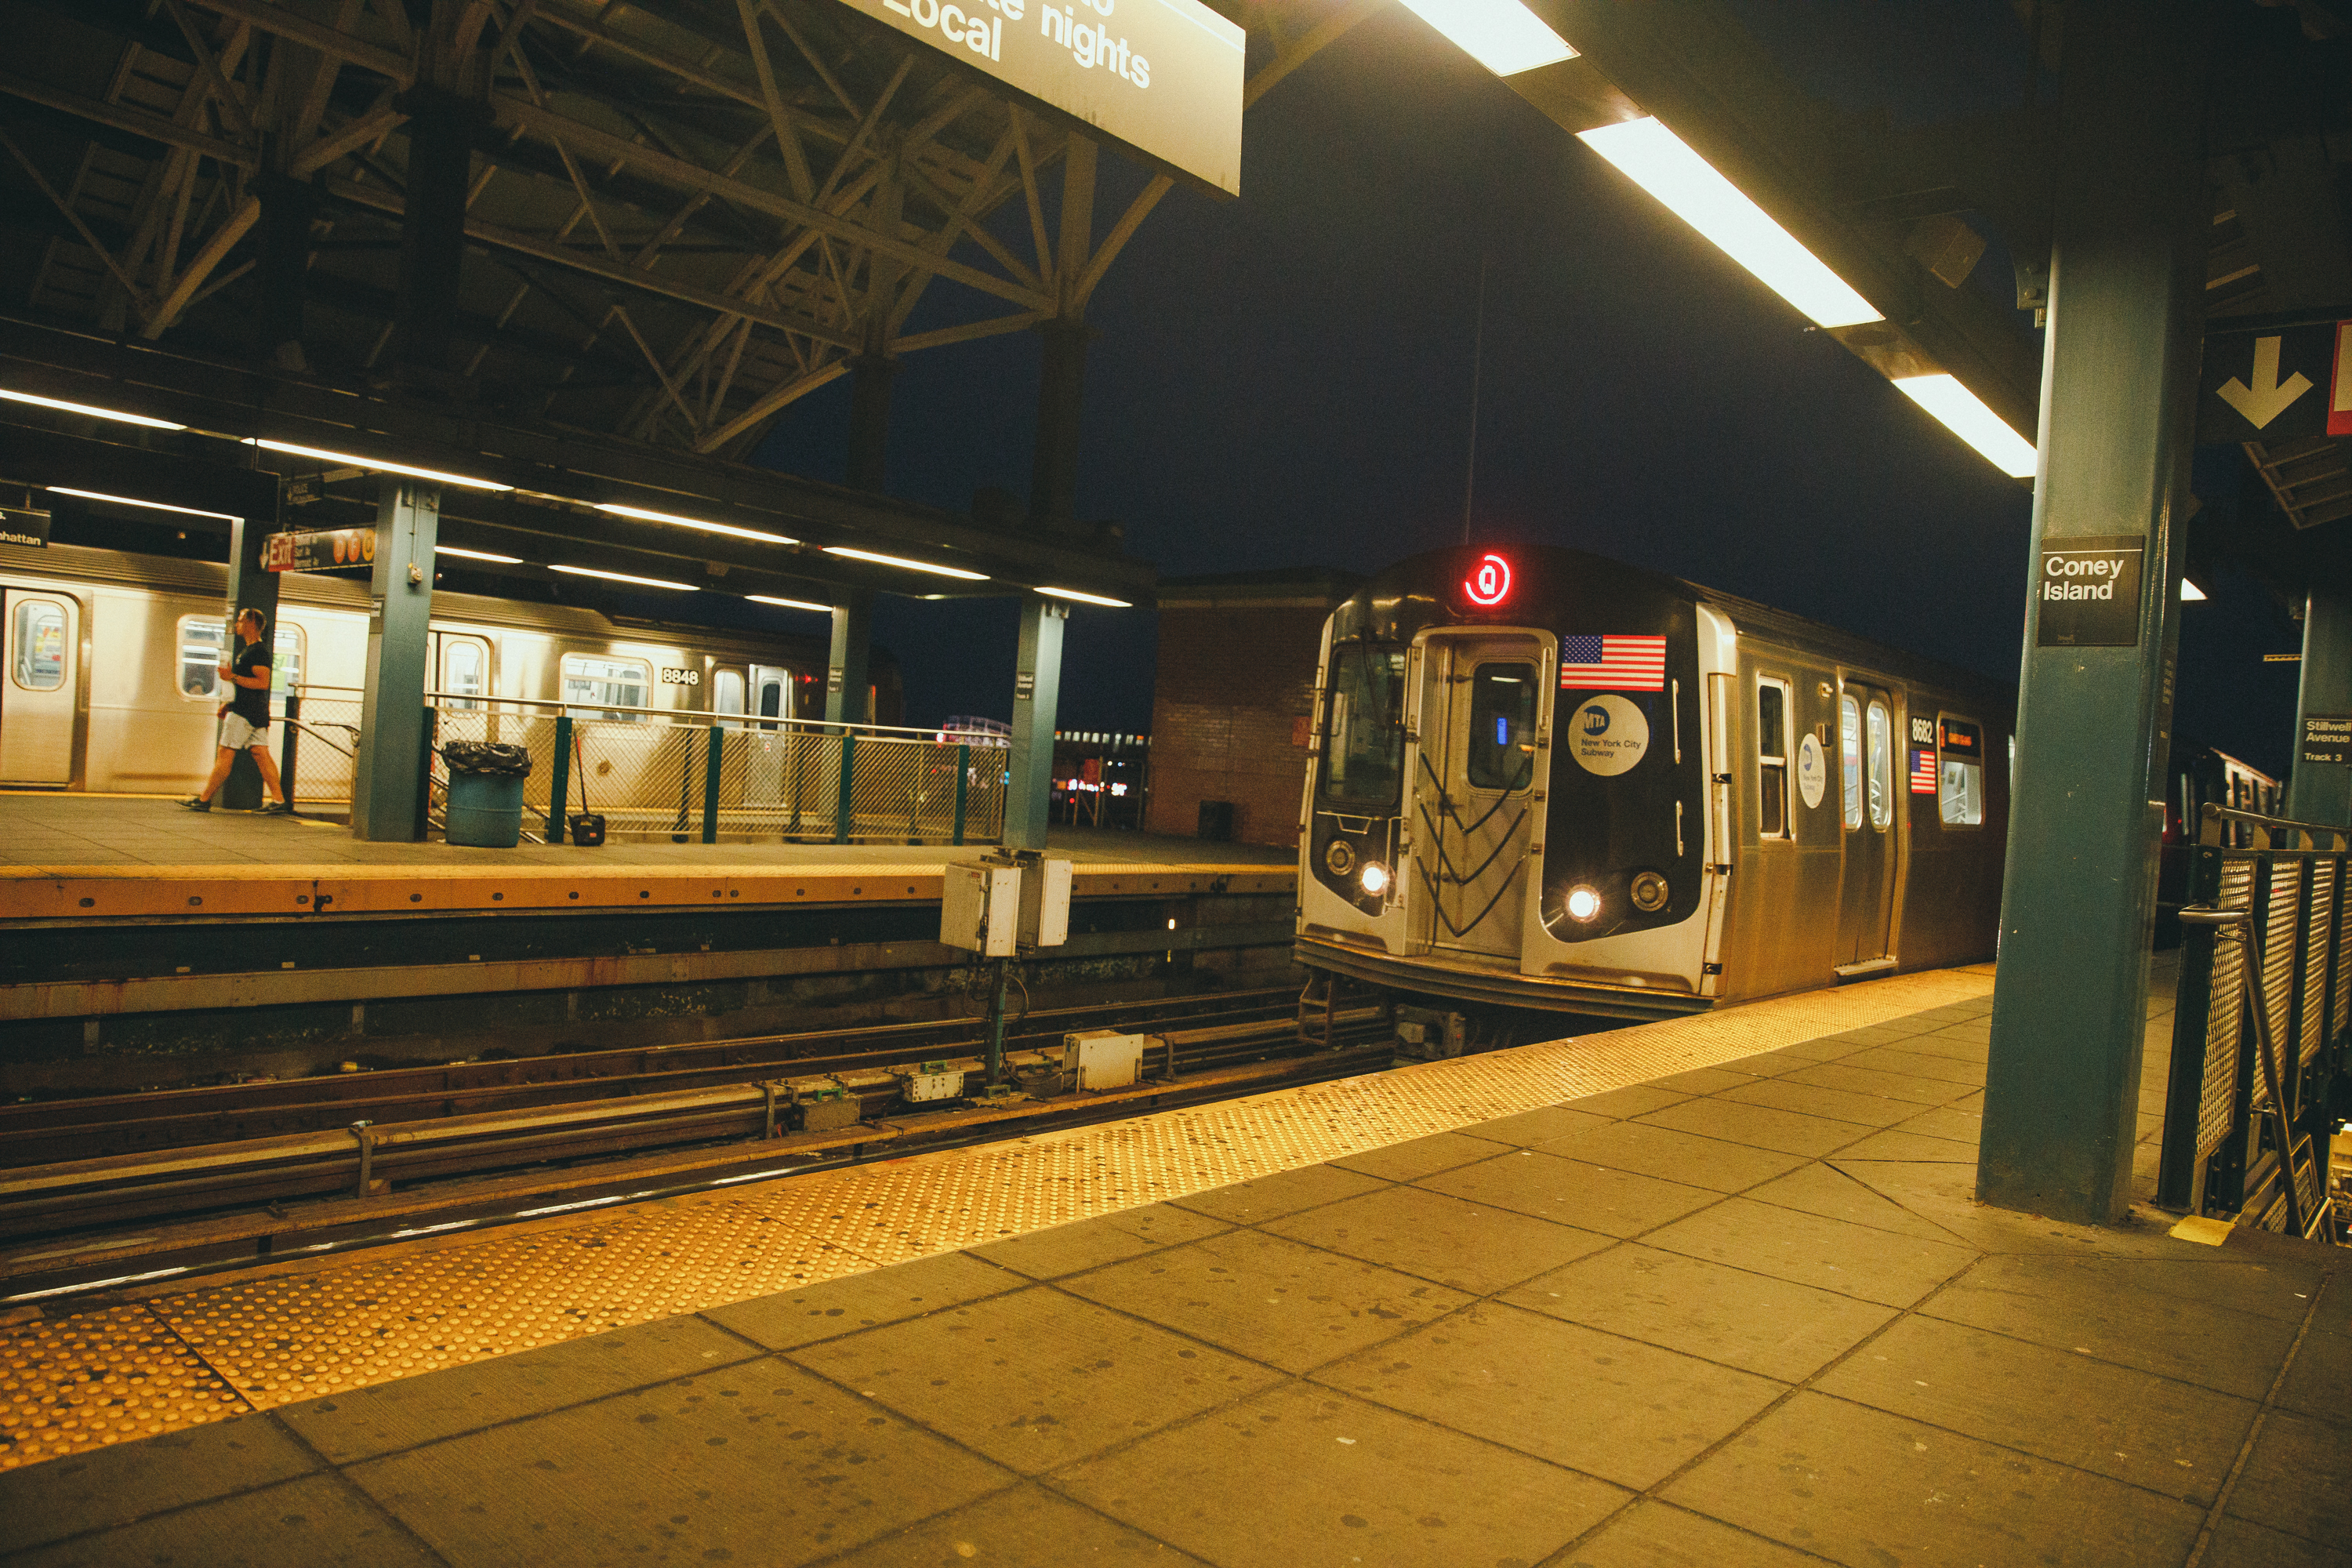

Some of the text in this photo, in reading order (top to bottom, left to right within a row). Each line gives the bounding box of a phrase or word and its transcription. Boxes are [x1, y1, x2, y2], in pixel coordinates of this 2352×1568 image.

[1041, 4, 1151, 89] nights
[2045, 556, 2125, 579] Coney
[2043, 579, 2114, 601] Island
[663, 668, 699, 685] 8848
[1584, 711, 1606, 729] MTA
[2307, 720, 2352, 731] Stillwell
[1912, 717, 1933, 744] 8682
[2306, 732, 2350, 743] Avenue
[1581, 739, 1599, 747] New
[1624, 740, 1642, 750] City
[1581, 748, 1614, 758] Subway
[2304, 753, 2343, 762] Track 3
